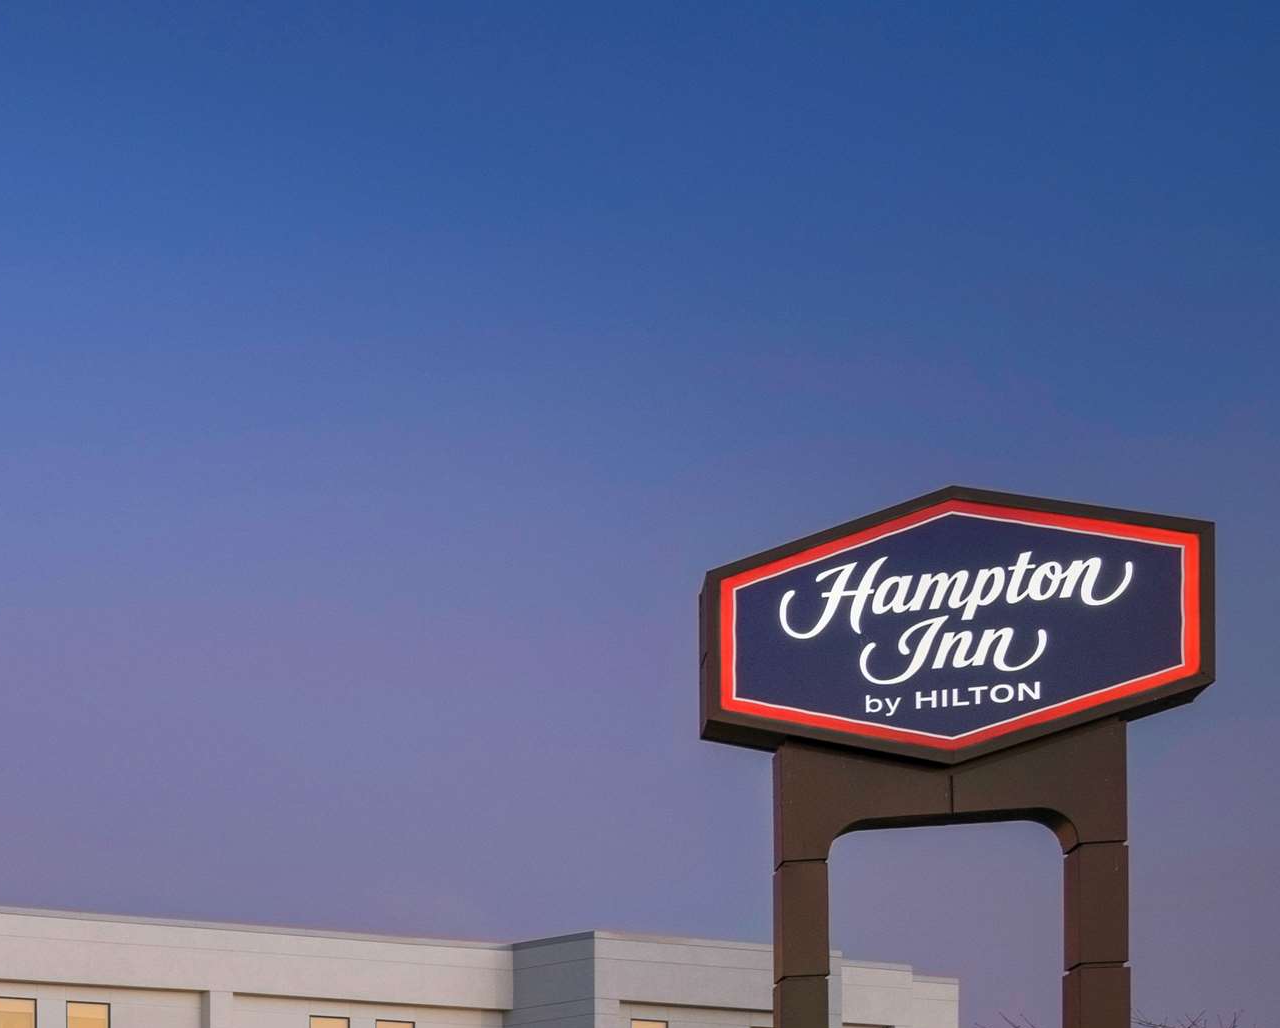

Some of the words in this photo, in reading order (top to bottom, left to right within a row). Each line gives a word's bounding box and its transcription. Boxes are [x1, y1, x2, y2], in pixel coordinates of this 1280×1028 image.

[778, 550, 1134, 640] Hampton
[859, 615, 1047, 685] Inn
[865, 694, 902, 716] by
[915, 681, 1042, 710] HILTON
